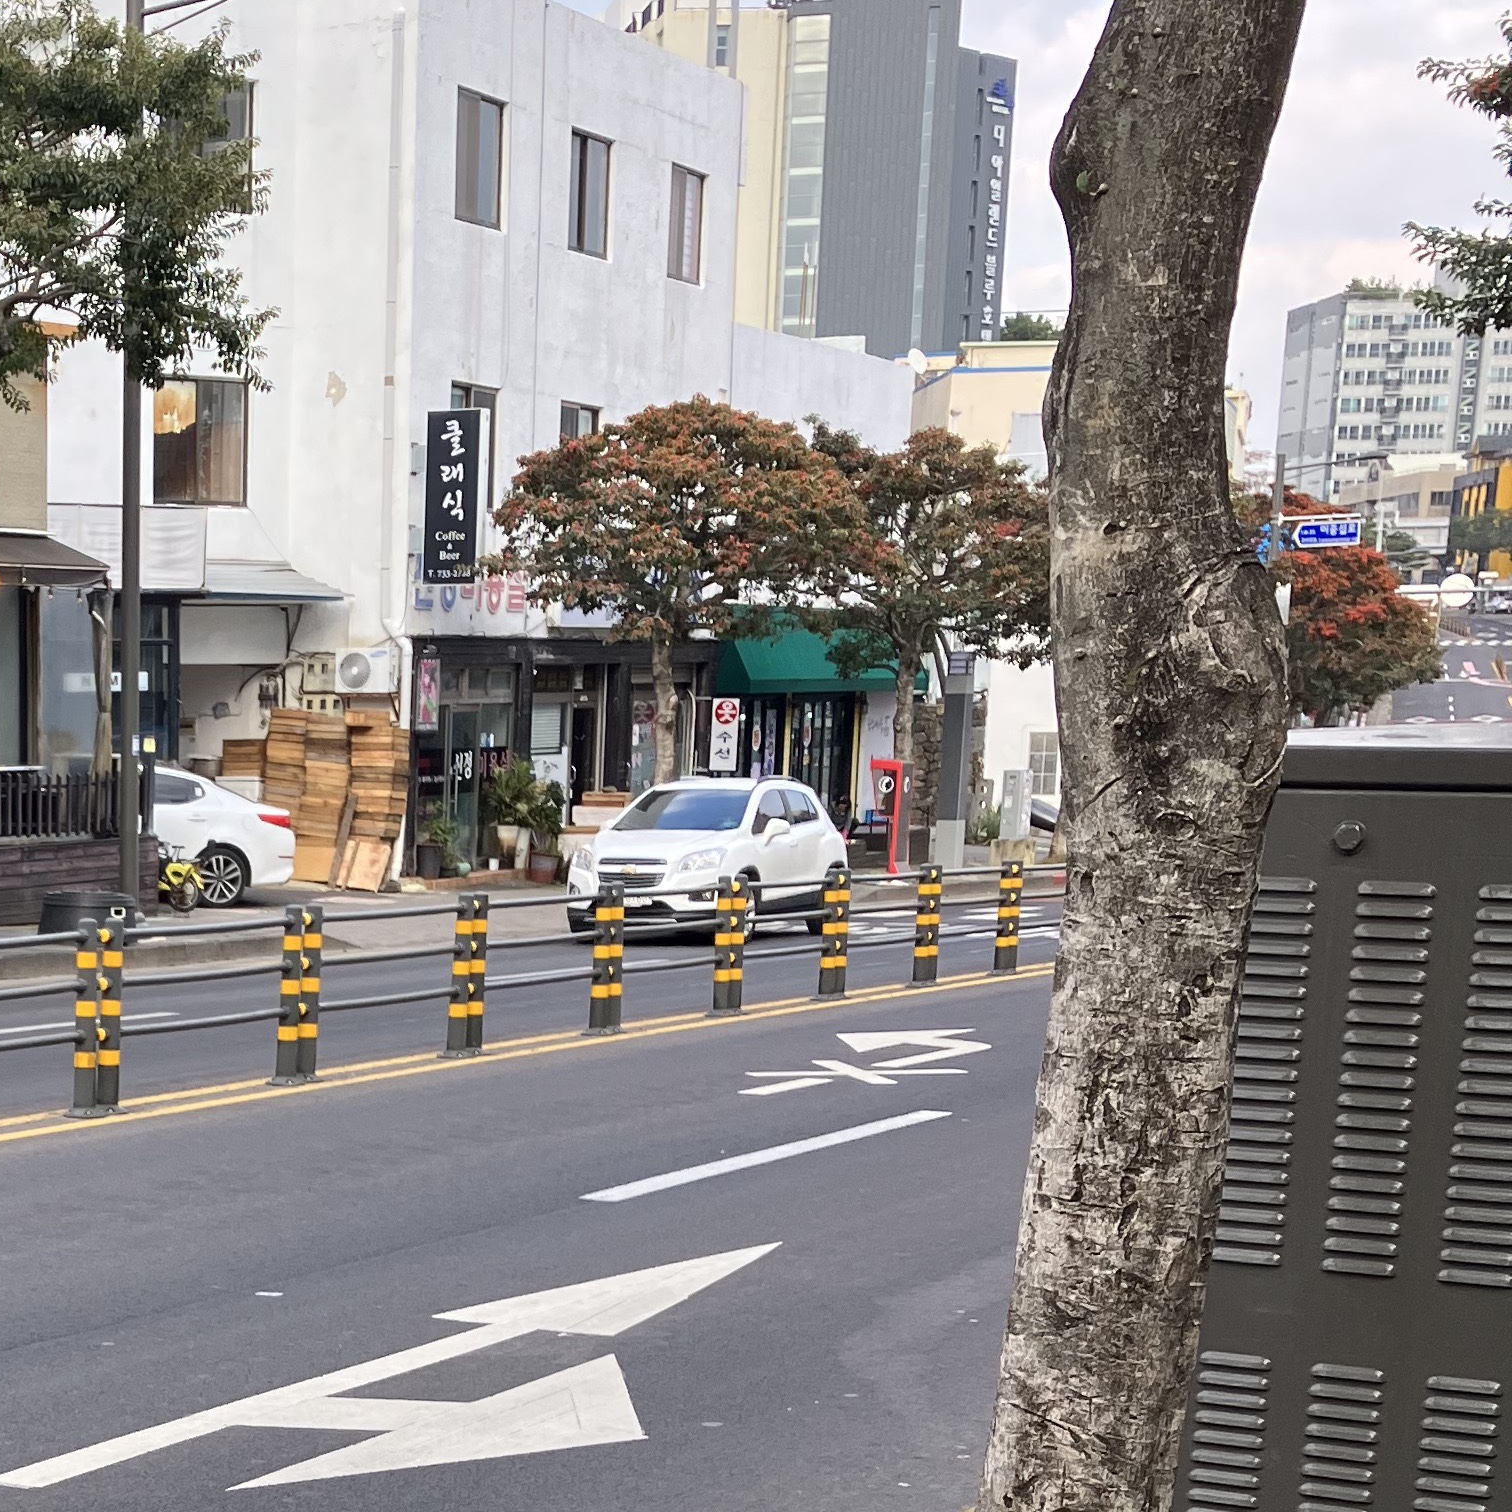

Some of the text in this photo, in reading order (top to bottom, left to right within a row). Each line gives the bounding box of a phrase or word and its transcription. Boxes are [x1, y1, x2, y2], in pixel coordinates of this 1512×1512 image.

[440, 419, 465, 521] 클래식
[435, 531, 466, 541] Coffee
[439, 551, 460, 560] Beer
